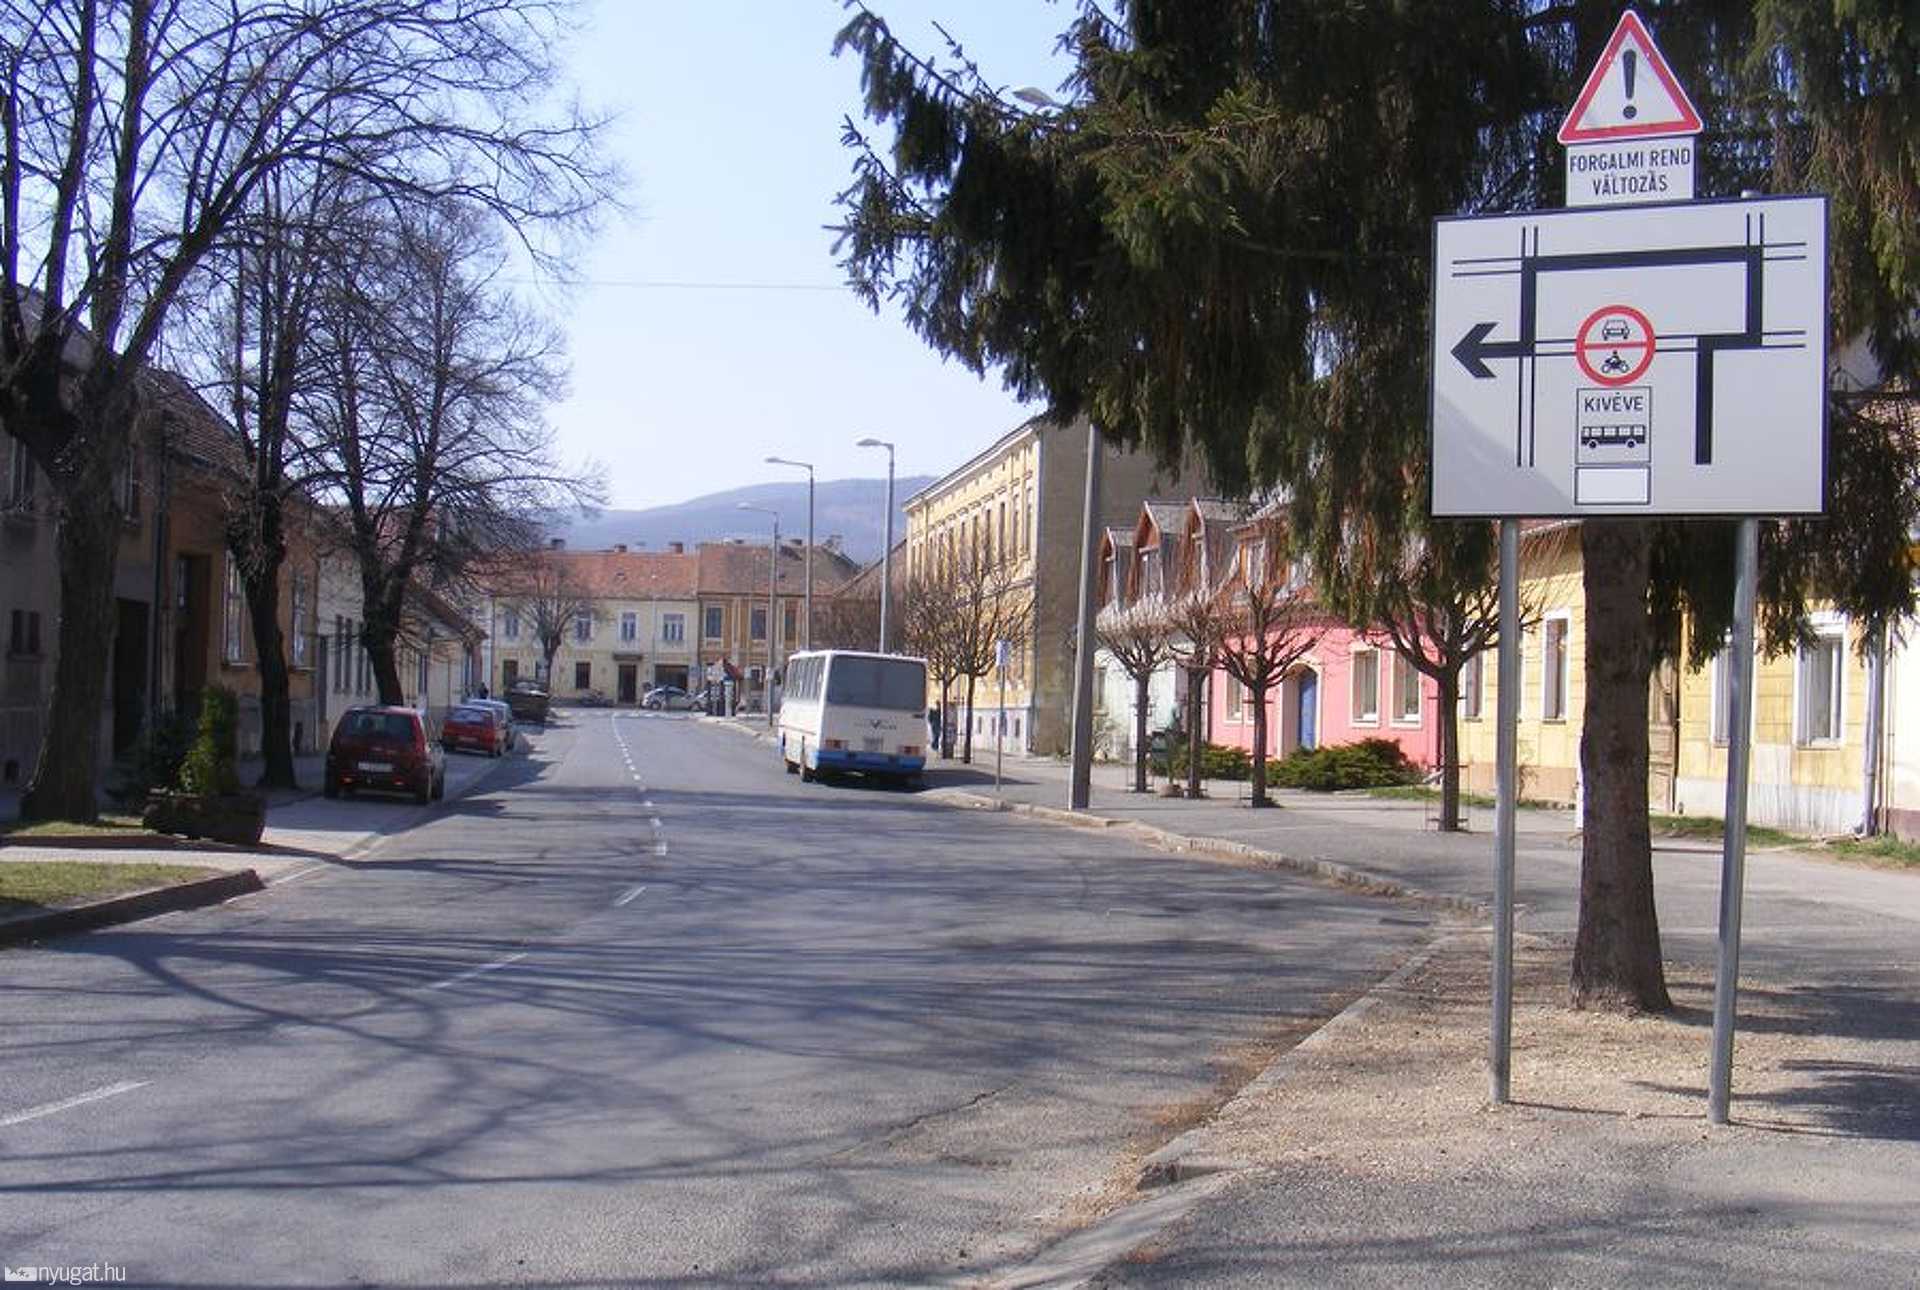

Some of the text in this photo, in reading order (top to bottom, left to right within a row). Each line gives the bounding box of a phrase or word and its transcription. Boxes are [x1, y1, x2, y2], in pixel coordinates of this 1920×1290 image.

[1570, 148, 1691, 173] FORGALMI REND
[1592, 171, 1668, 195] VÁLTOZÁS
[1584, 391, 1644, 412] KIVÉVE
